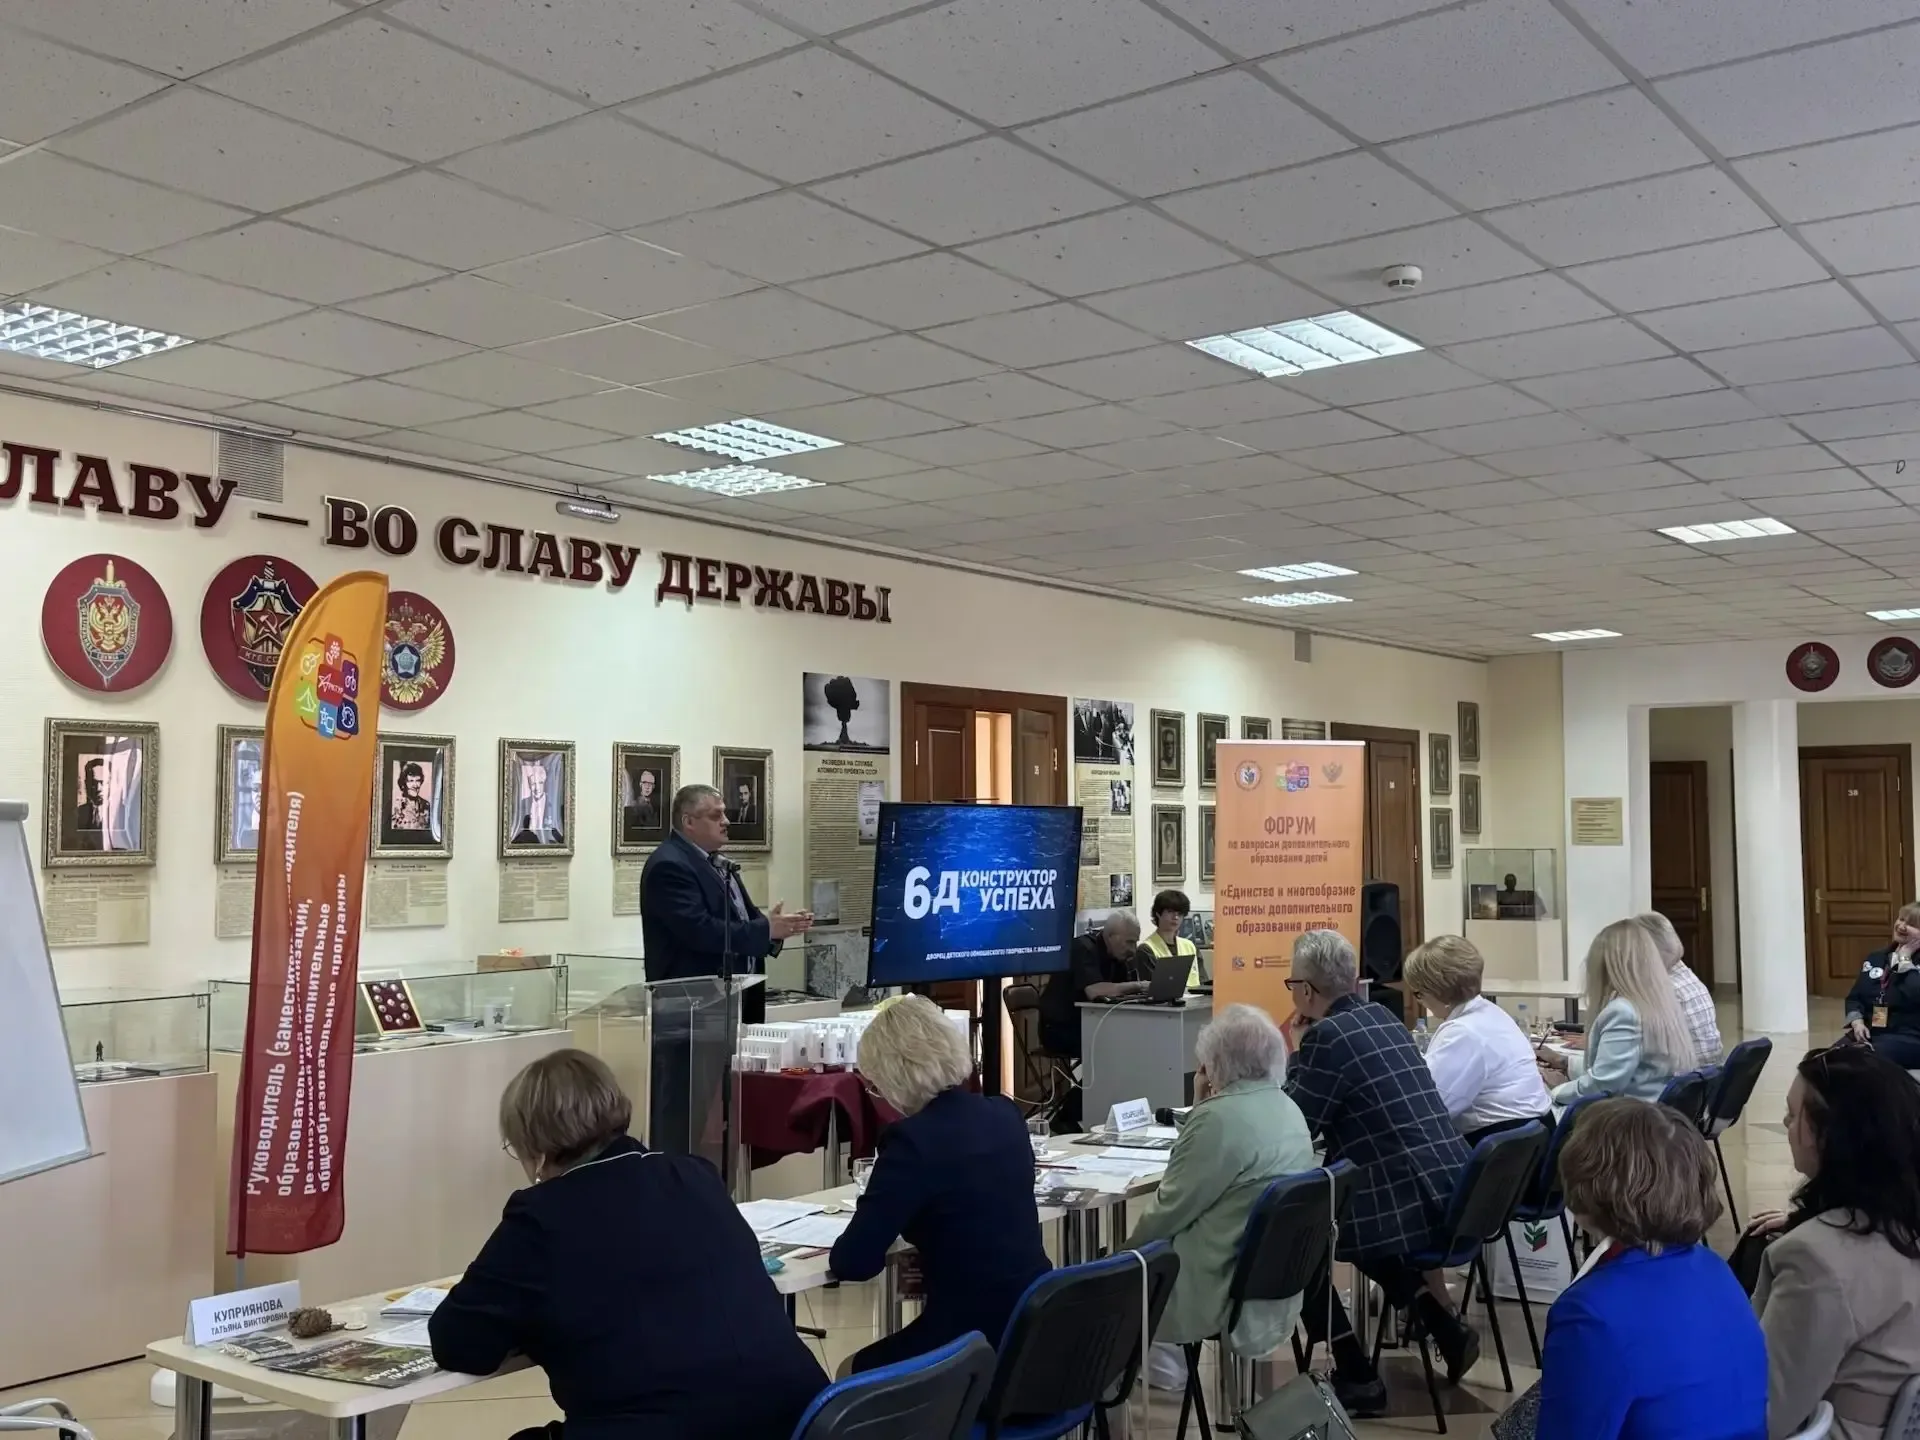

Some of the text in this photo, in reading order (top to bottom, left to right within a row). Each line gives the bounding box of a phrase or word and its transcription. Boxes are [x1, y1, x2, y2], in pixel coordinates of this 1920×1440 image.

[323, 495, 418, 556] ВО
[438, 517, 641, 588] СЛАВУ
[655, 550, 893, 623] ДЕРЖАВЫ
[1264, 816, 1316, 835] ФОРУМ
[1227, 840, 1238, 850] по
[1305, 851, 1328, 864] детей
[903, 865, 1058, 920] 6Д КОНСТРУКТОР
[979, 886, 1056, 913] УСПЕХА
[1220, 883, 1356, 900] «Единство и многообразие
[1222, 902, 1353, 916] системы дополнительного
[1236, 919, 1301, 936] образования
[925, 952, 946, 961] ДВОРЕЦ
[303, 903, 331, 1058] дополнительные
[316, 873, 348, 1192] общеобразовательные программы
[246, 1062, 286, 1196] Руководитель
[213, 1297, 284, 1323] КУПРИЯНОВА
[210, 1311, 289, 1336] ТАТЬЯНА ВИКТОРОВНА
